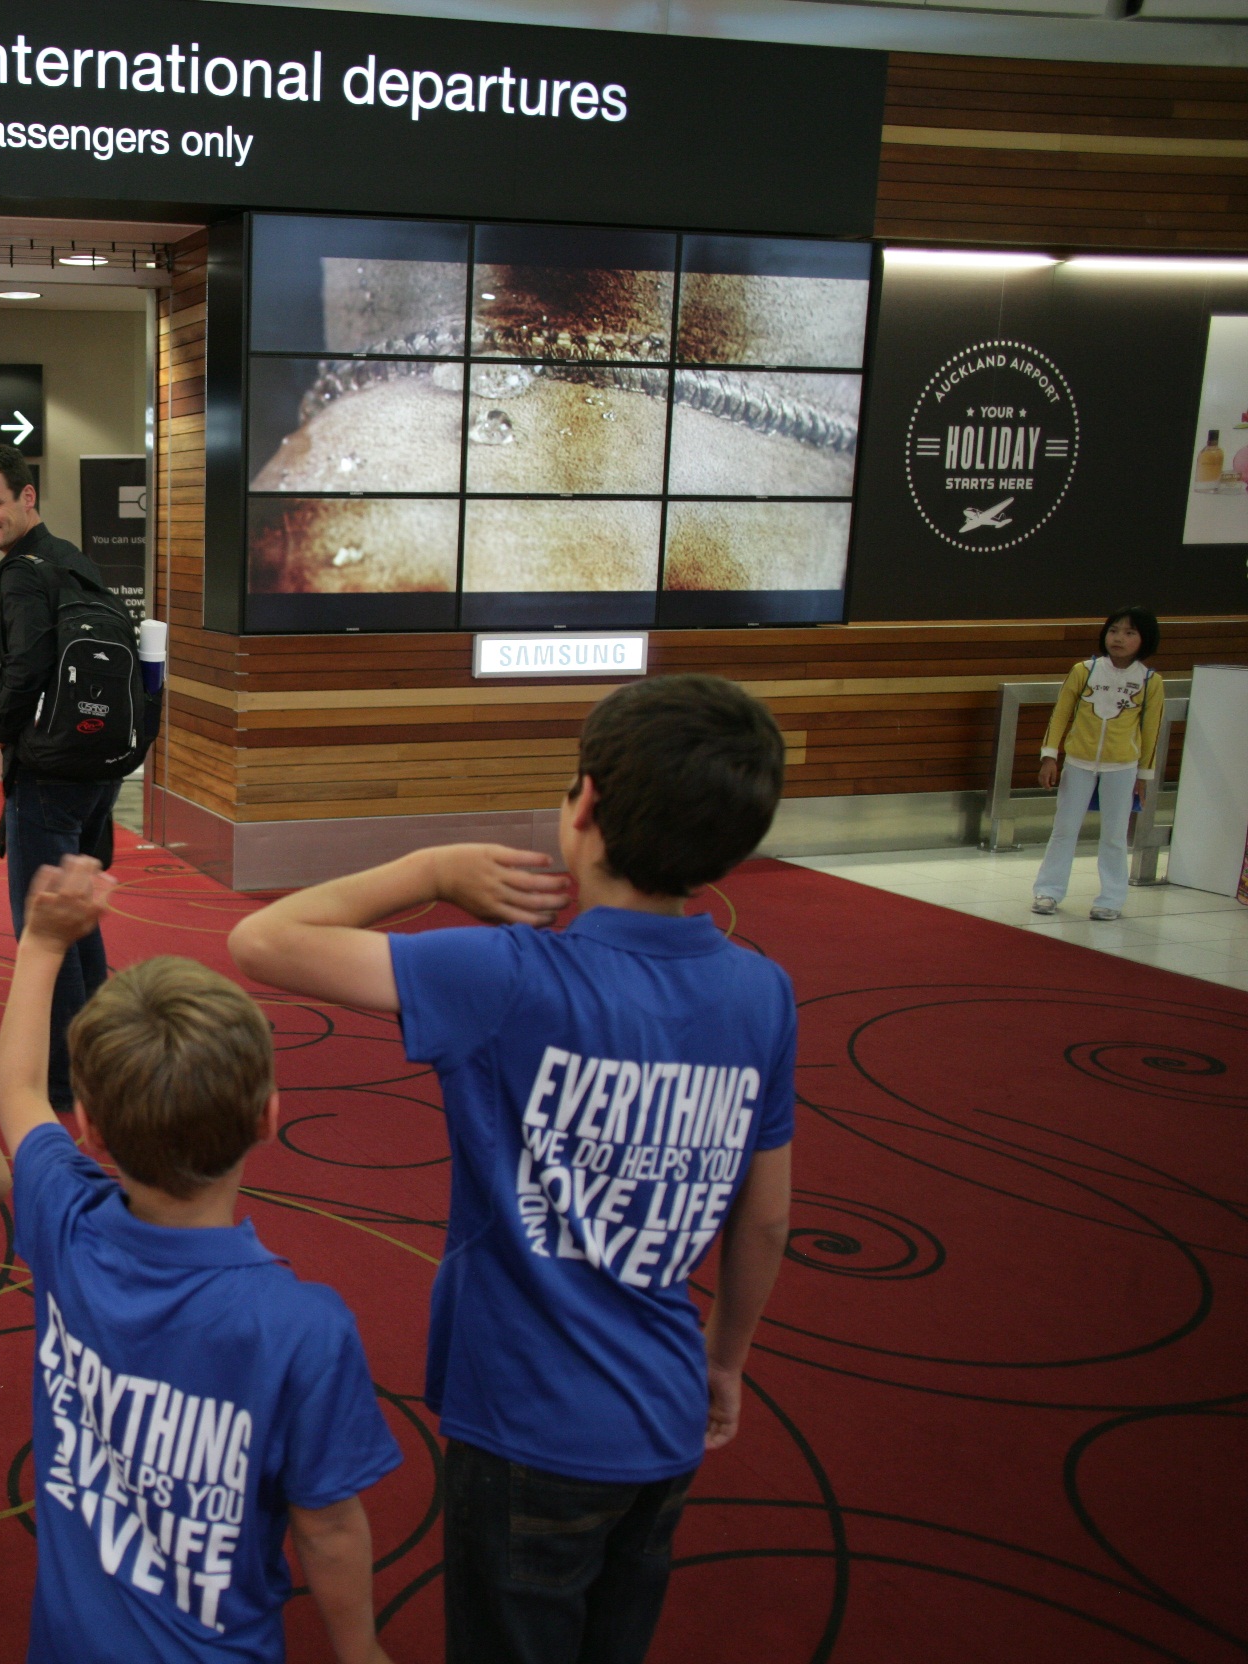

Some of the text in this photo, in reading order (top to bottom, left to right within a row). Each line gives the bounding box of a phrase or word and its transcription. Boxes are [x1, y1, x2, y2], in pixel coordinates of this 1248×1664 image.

[342, 53, 628, 123] departures
[181, 124, 254, 167] only
[934, 354, 1060, 404] AUCKLAND AIRPORT
[980, 406, 1014, 419] YOUR
[945, 425, 1041, 470] HOLIDAY
[945, 477, 1033, 490] STARTS HERE
[91, 534, 109, 545] You
[111, 536, 129, 544] can
[121, 585, 144, 595] have
[499, 642, 627, 668] SAMSUNG
[522, 1044, 761, 1150] EVERYTHING
[522, 1124, 744, 1183] WE DO HELPS YOU
[516, 1147, 734, 1231] LOVE LIFE
[518, 1194, 551, 1258] AND
[186, 1480, 245, 1526] YOU
[174, 1562, 232, 1635] IT.
